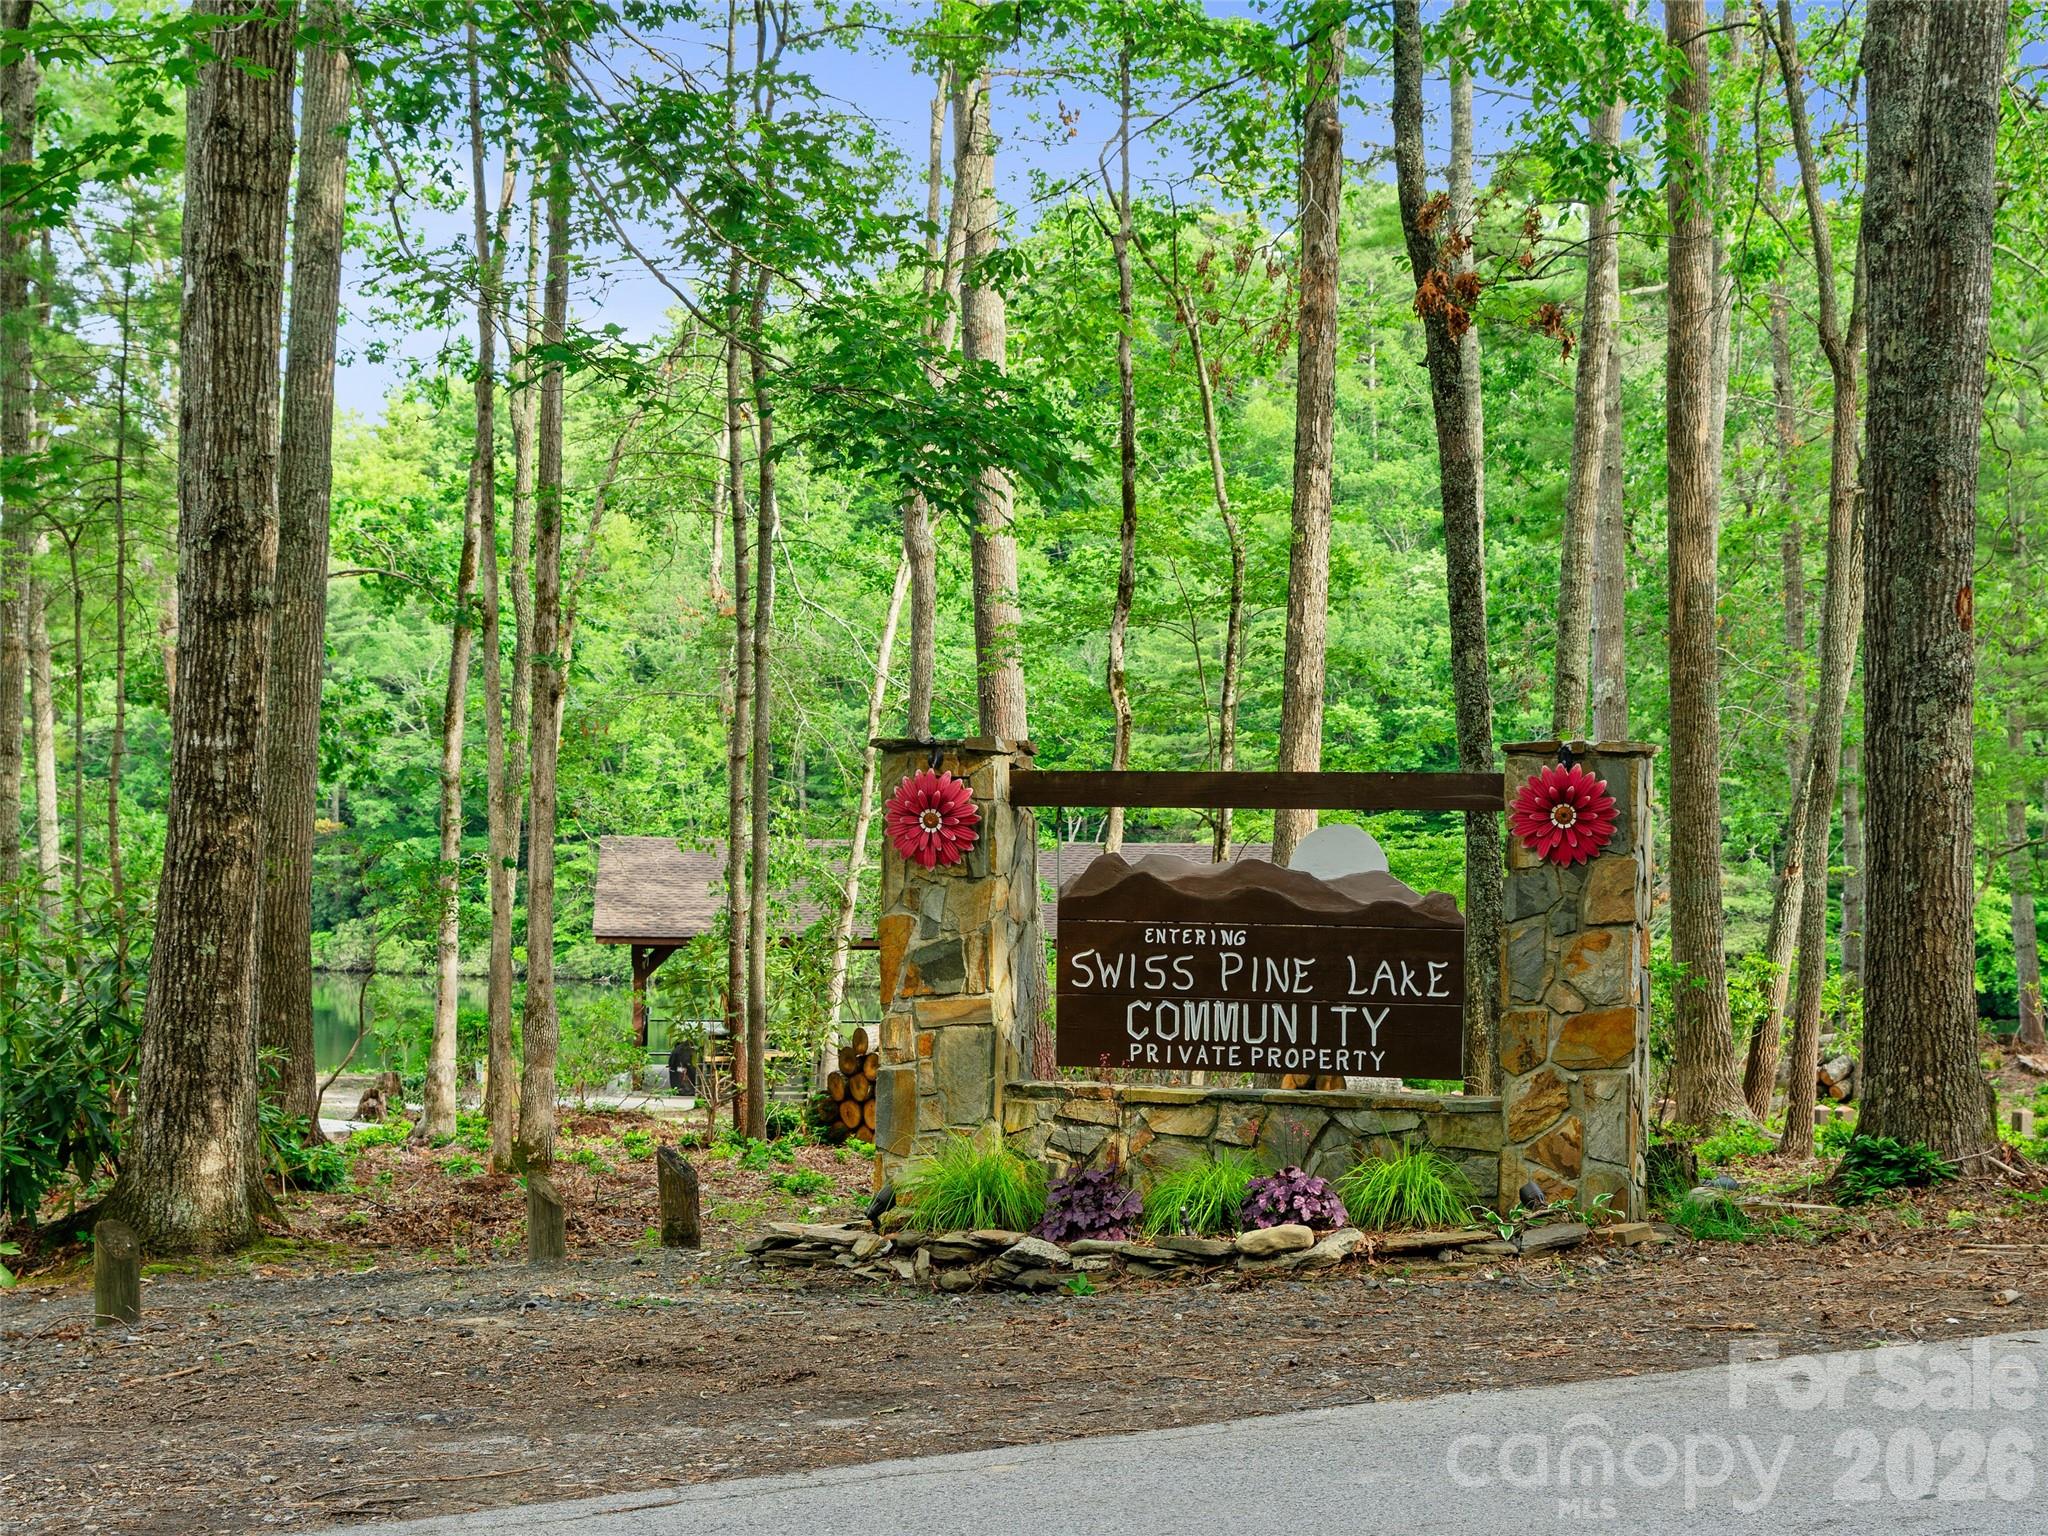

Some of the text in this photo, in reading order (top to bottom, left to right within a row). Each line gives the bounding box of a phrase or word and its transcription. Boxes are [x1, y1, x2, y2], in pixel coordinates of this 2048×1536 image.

[1144, 928, 1247, 946] ENTERING
[1071, 948, 1450, 998] SWISS PINE LAKE
[1126, 999, 1391, 1047] COMMUNITY
[1129, 1043, 1386, 1072] PRIVATE PROPERTY
